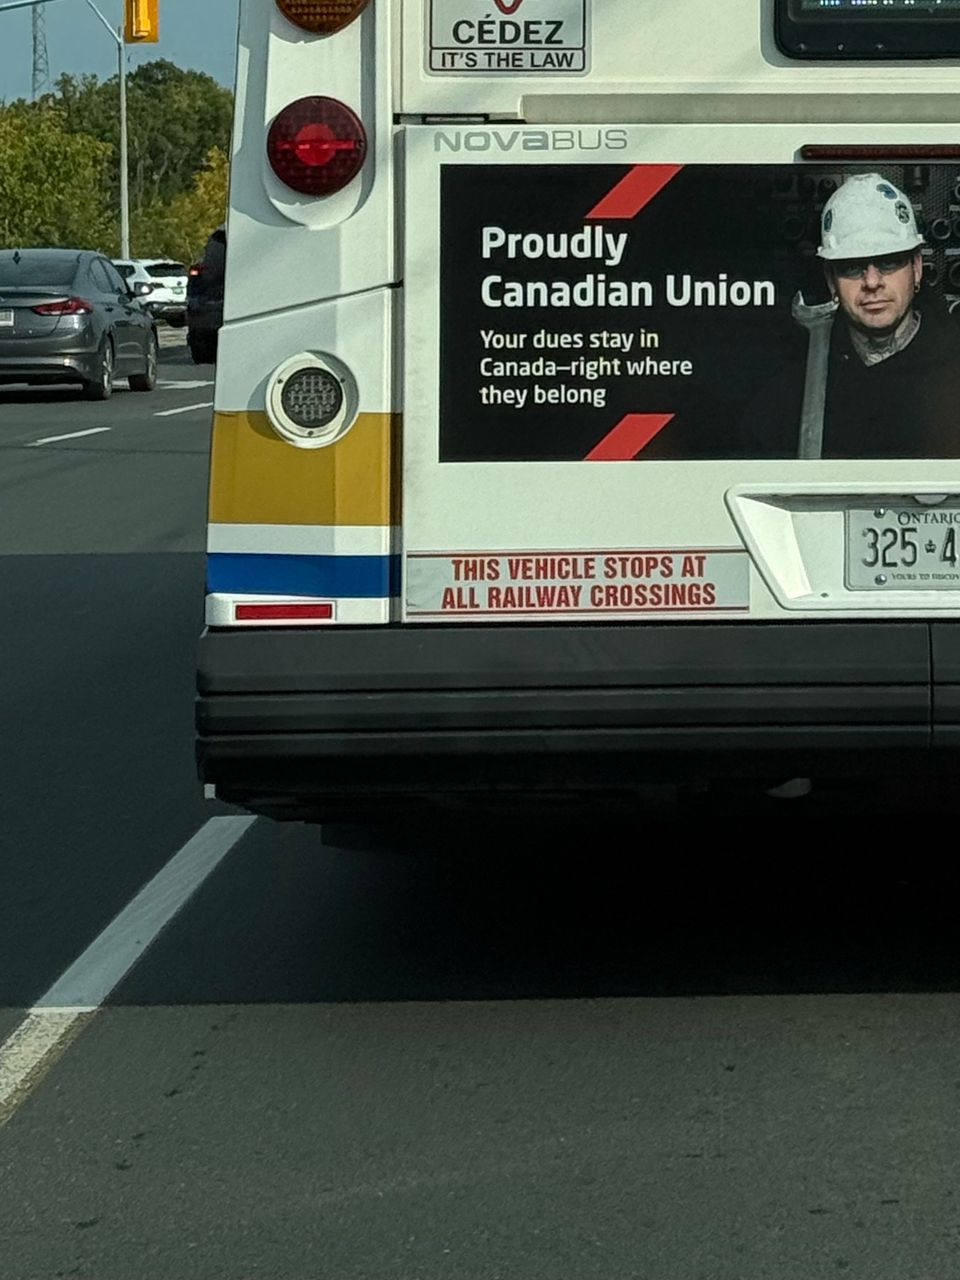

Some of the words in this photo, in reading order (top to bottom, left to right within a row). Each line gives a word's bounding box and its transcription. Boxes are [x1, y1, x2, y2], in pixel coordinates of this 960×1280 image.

[452, 13, 564, 45] CÉDEZ
[441, 52, 478, 68] IT'S
[484, 52, 524, 68] THE
[530, 52, 575, 68] LAW
[481, 225, 629, 266] Proudly
[480, 273, 653, 308] Canadian
[665, 273, 776, 307] Union
[480, 329, 528, 349] Your
[533, 329, 584, 349] dues
[589, 330, 634, 352] stay
[640, 328, 659, 348] in
[626, 356, 693, 376] where
[479, 385, 528, 408] they
[534, 384, 606, 407] belong
[862, 527, 918, 568] 325
[452, 559, 500, 580] THIS
[508, 558, 596, 580] VEHICLE
[604, 556, 673, 579] STOPS
[681, 556, 706, 577] AT
[441, 587, 480, 609] ALL
[488, 585, 582, 609] RAILWAY
[590, 583, 716, 607] CROSSINGS
